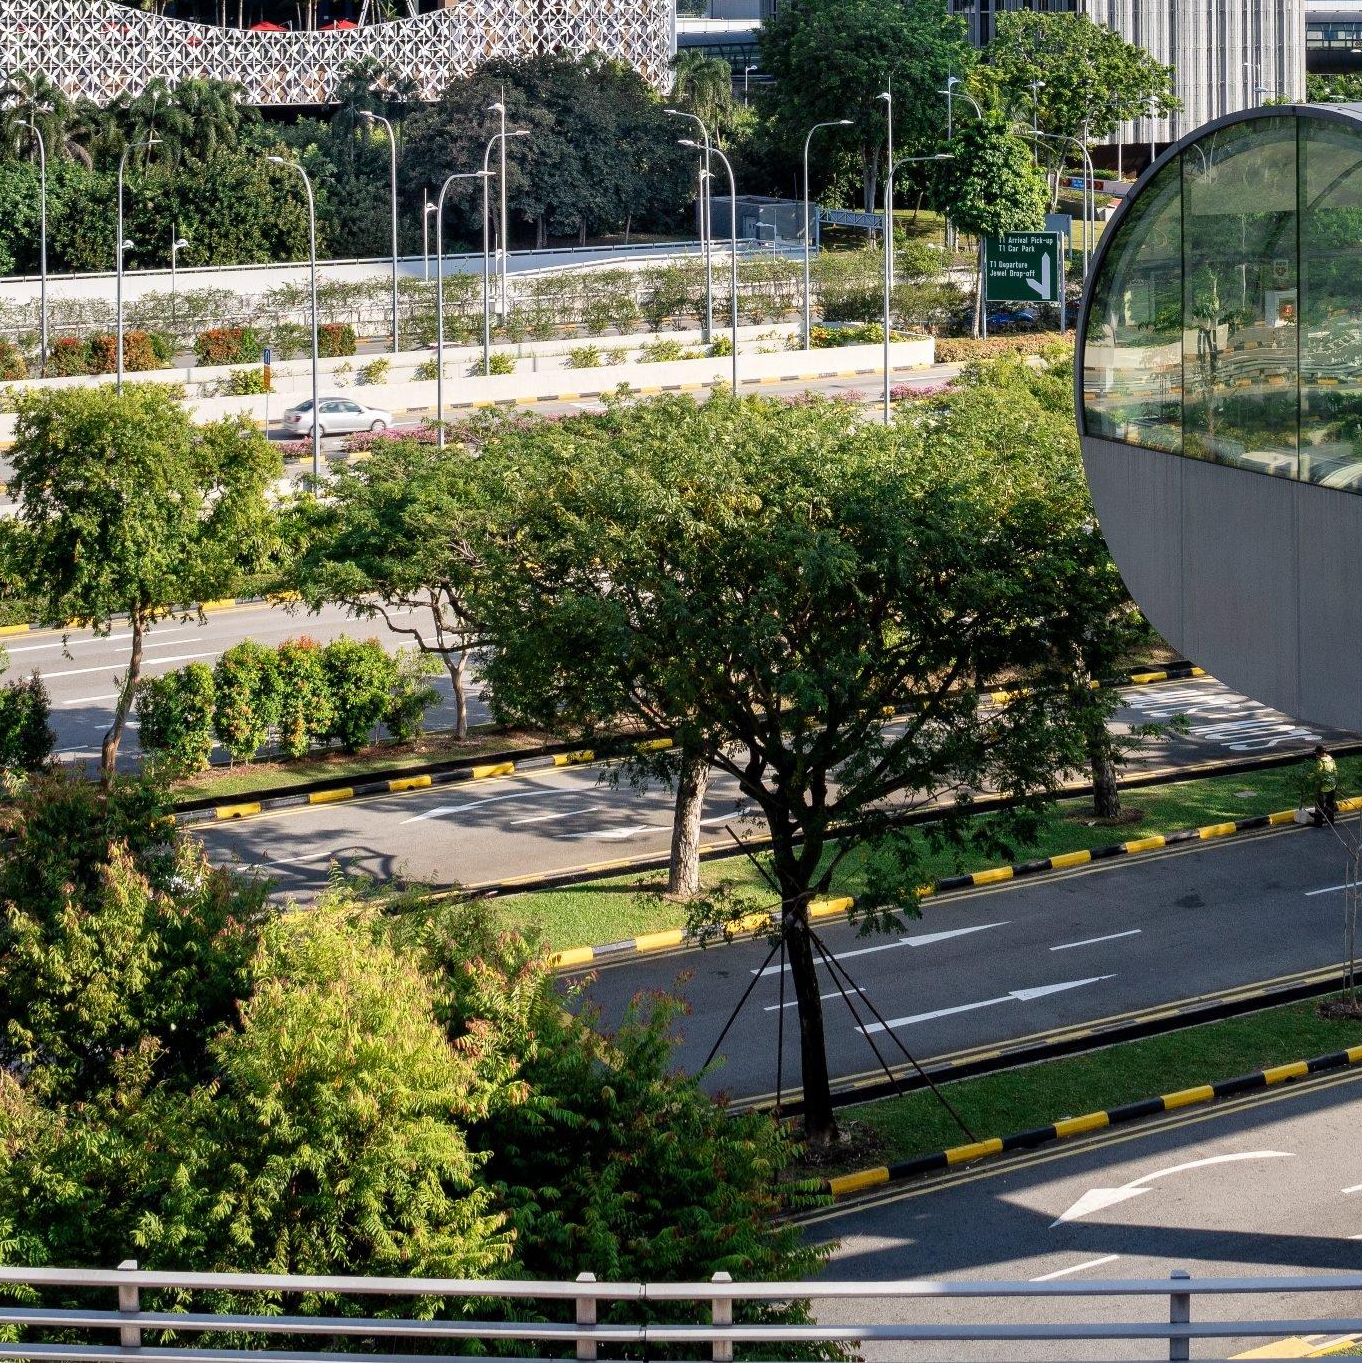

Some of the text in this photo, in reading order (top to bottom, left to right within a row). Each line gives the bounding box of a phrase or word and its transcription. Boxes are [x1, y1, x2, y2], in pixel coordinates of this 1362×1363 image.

[1008, 236, 1028, 244] Arrival
[1030, 236, 1054, 245] Pick-up
[998, 244, 1035, 252] T1 Car Park
[989, 260, 1028, 269] T1 Departure
[989, 269, 1036, 278] Jewel Drop-off
